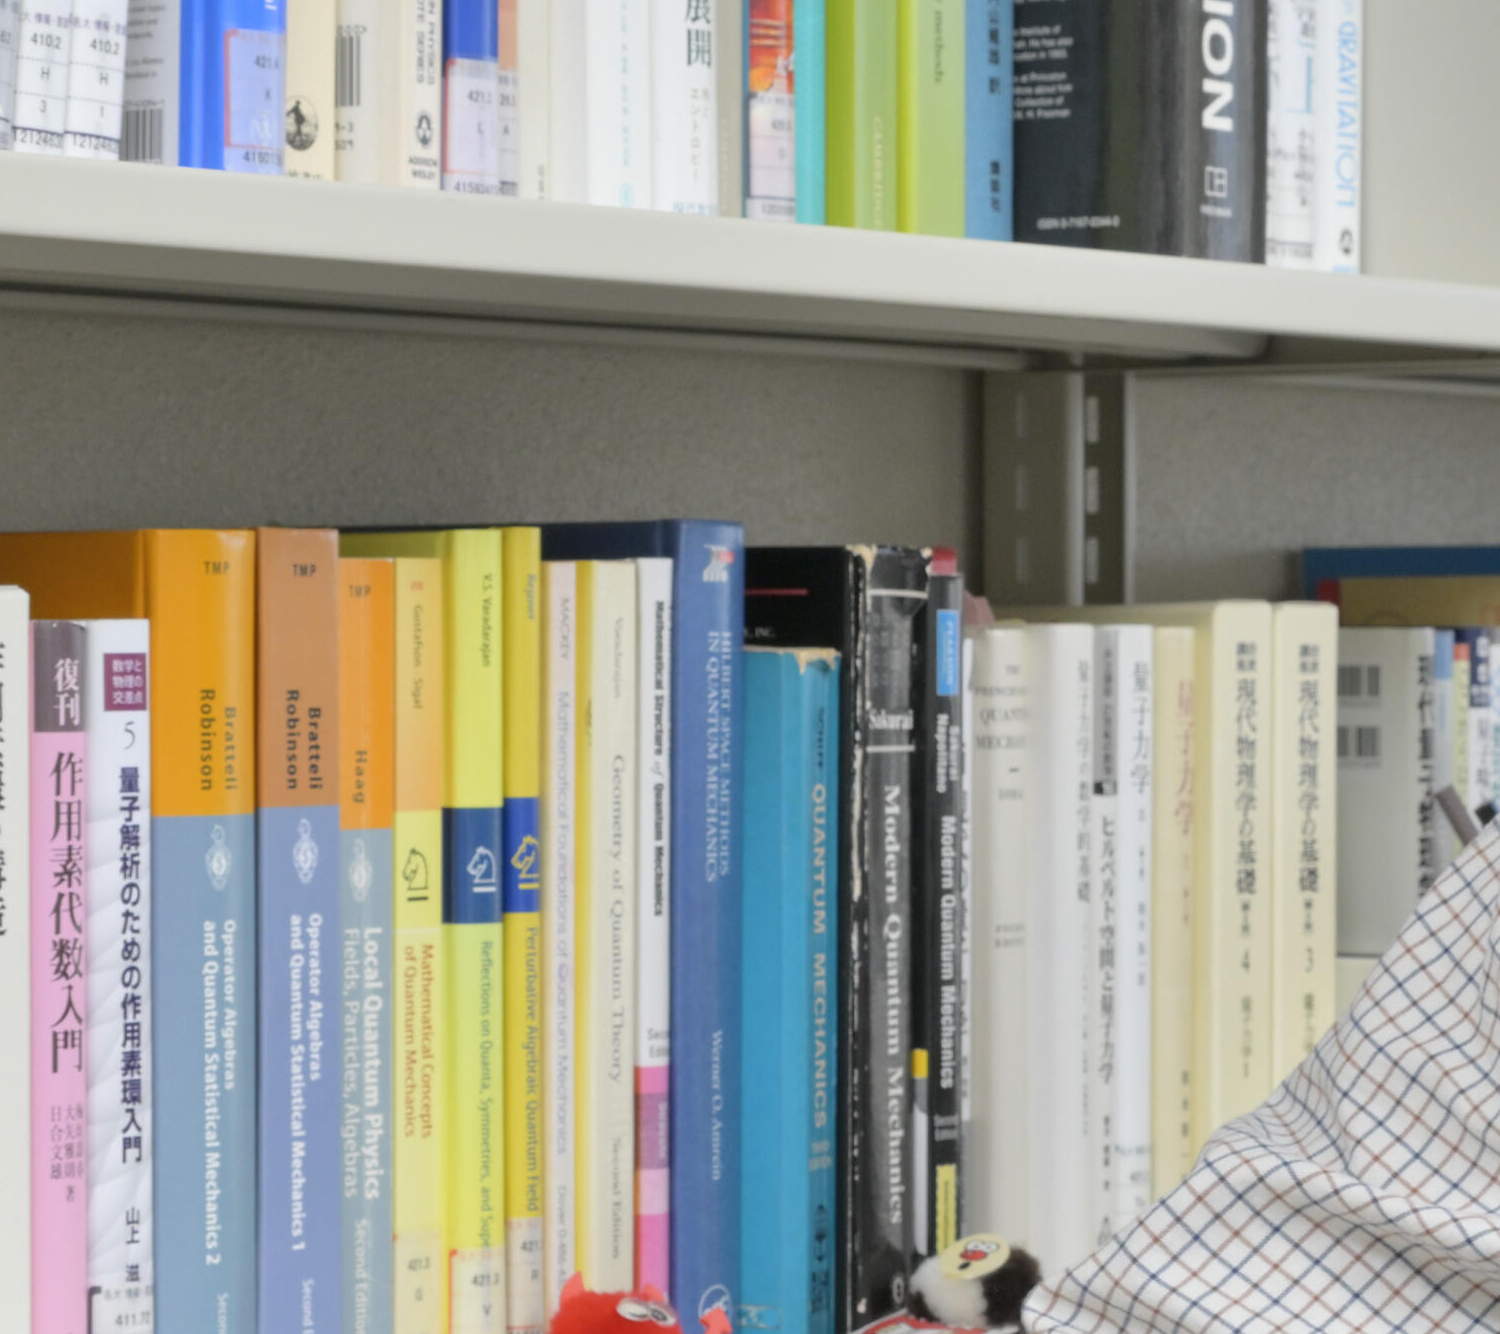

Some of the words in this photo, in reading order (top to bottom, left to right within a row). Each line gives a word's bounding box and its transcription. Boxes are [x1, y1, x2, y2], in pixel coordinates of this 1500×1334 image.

[122, 720, 137, 751] 5
[200, 688, 217, 792] Robinson
[286, 689, 301, 791] Robinson
[308, 706, 323, 791] Bratteli
[812, 783, 827, 935] QUANTUM
[884, 785, 901, 904] Modern
[49, 751, 84, 1074] 作用素代数入門
[203, 920, 216, 955] and
[222, 919, 237, 1003] Operator
[363, 926, 384, 979] Local
[117, 766, 143, 1164] 量子解析のための作用素環入門
[203, 958, 218, 1048] Quantum
[881, 913, 902, 1057] Quantum
[221, 1010, 237, 1091] Algebras
[363, 984, 384, 1108] Quantum
[813, 952, 828, 1129] MECHANICS
[204, 1051, 220, 1139] Statistical
[887, 1067, 906, 1225] Mechanics
[205, 1144, 221, 1247] Mechanics
[363, 1111, 385, 1201] Physics
[206, 1250, 222, 1266] 2
